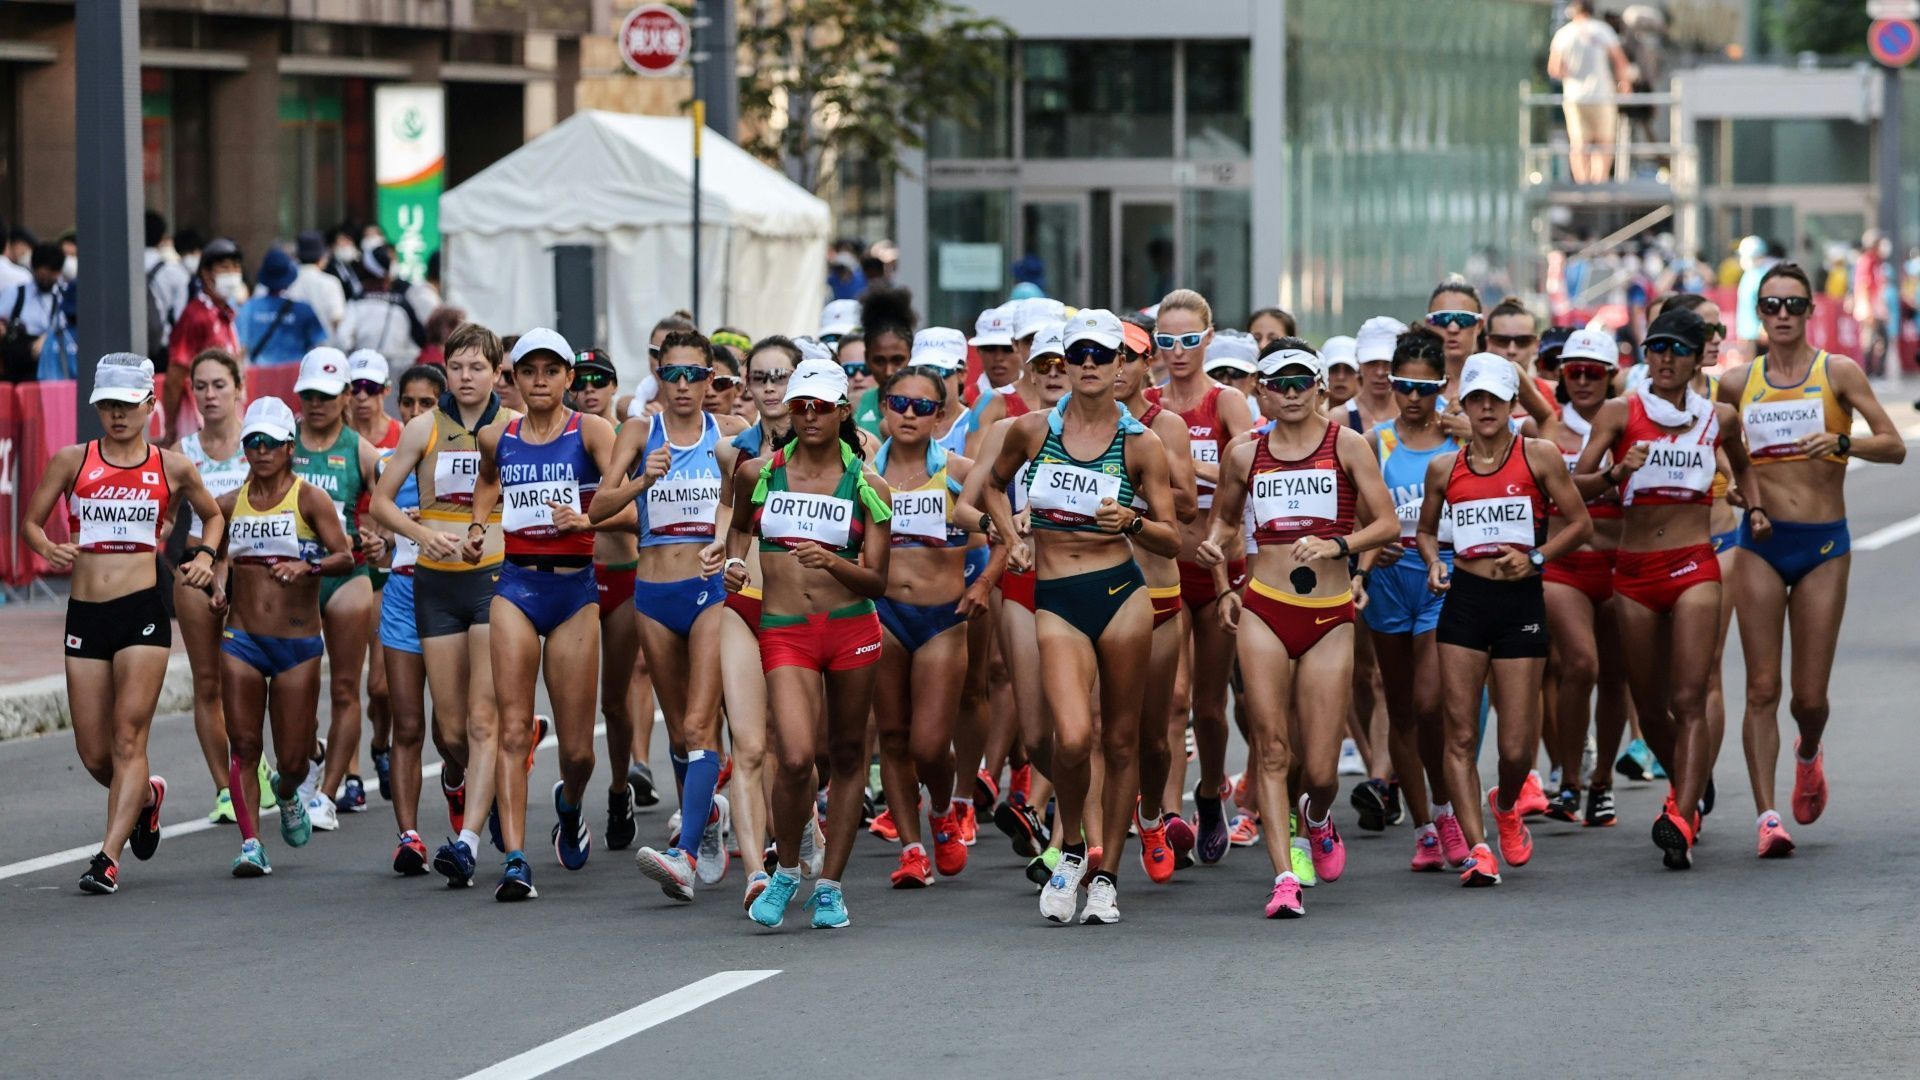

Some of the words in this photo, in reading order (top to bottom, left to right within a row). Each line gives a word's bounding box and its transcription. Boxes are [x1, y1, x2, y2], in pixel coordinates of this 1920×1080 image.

[1650, 449, 1703, 469] ANDIA
[501, 464, 538, 483] COSTA
[543, 463, 575, 481] RICA
[1668, 470, 1684, 480] 150
[1050, 471, 1098, 495] SENA
[1256, 477, 1332, 498] QIEYANG
[91, 485, 151, 500] JAPAN
[509, 487, 573, 509] VARGAS
[1066, 495, 1077, 504] 14
[683, 507, 699, 515] 110
[770, 497, 846, 522] ORTUNO
[893, 497, 943, 516] REJON
[1288, 500, 1300, 509] 22
[83, 505, 156, 522] KAWAZOE
[535, 510, 545, 518] 41
[1457, 504, 1527, 527] BEKMEZ
[113, 526, 127, 535] 121
[232, 520, 291, 538] P.PEREZ
[798, 521, 814, 531] 141
[1482, 526, 1499, 536] 173
